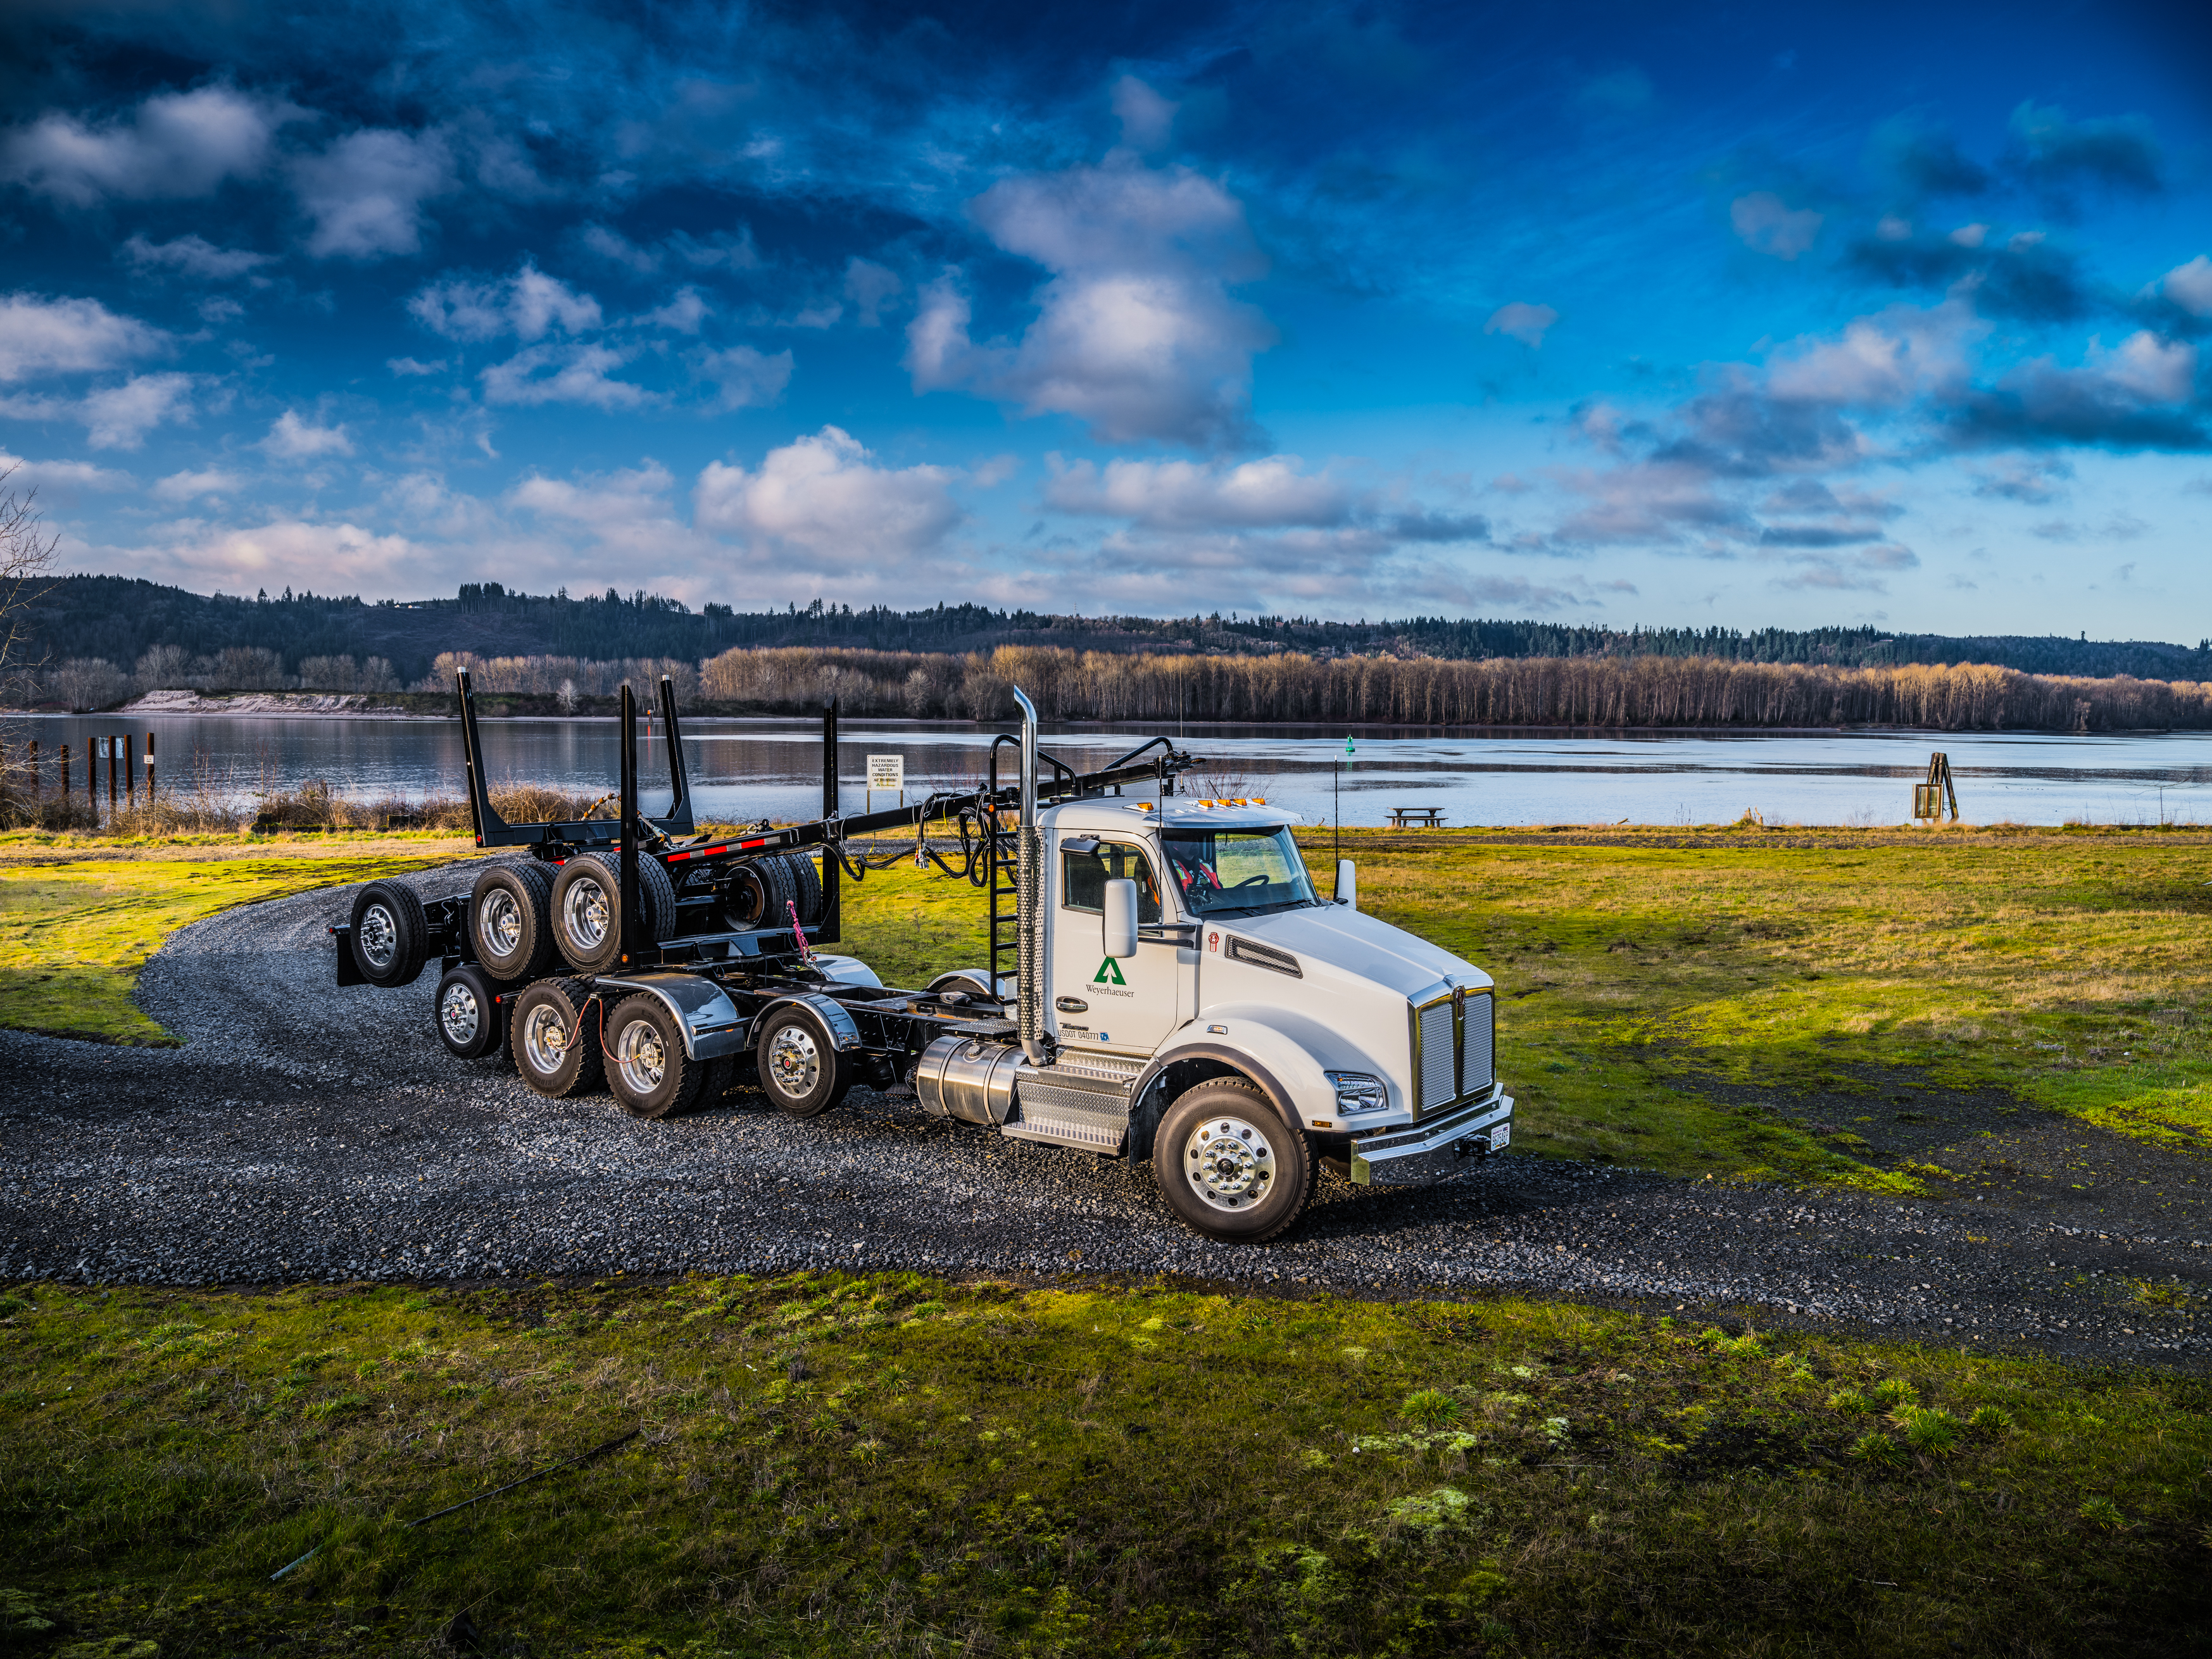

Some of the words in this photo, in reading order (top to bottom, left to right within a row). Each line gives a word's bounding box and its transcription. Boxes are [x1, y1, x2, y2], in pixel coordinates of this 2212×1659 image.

[1086, 984, 1134, 998] Weyerhaeuser
[541, 992, 565, 1013] L320
[641, 1009, 666, 1036] L320
[1057, 1029, 1076, 1039] USDOT
[1078, 1031, 1099, 1041] 040777
